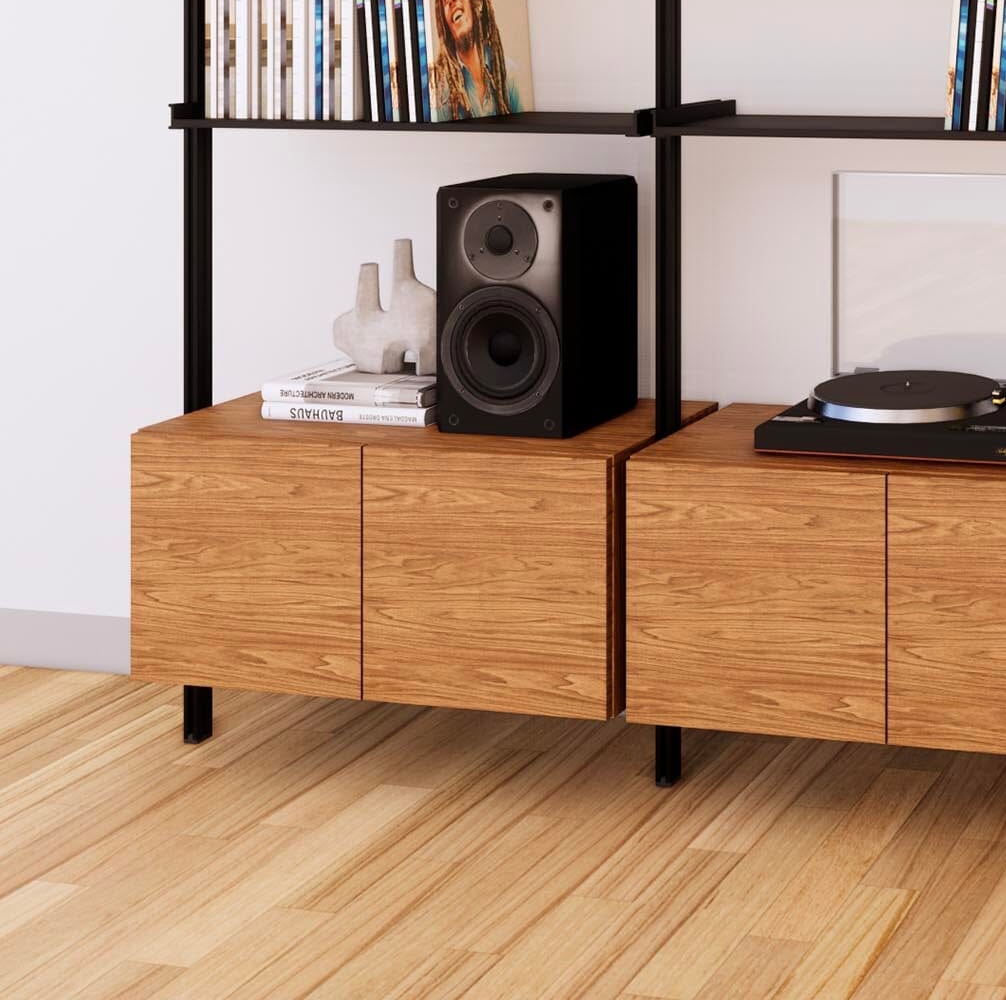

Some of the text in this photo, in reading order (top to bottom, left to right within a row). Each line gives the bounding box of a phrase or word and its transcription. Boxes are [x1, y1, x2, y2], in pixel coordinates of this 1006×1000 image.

[280, 389, 354, 400] MODERN ARCHITECTURE
[290, 408, 344, 421] BAUHAUS
